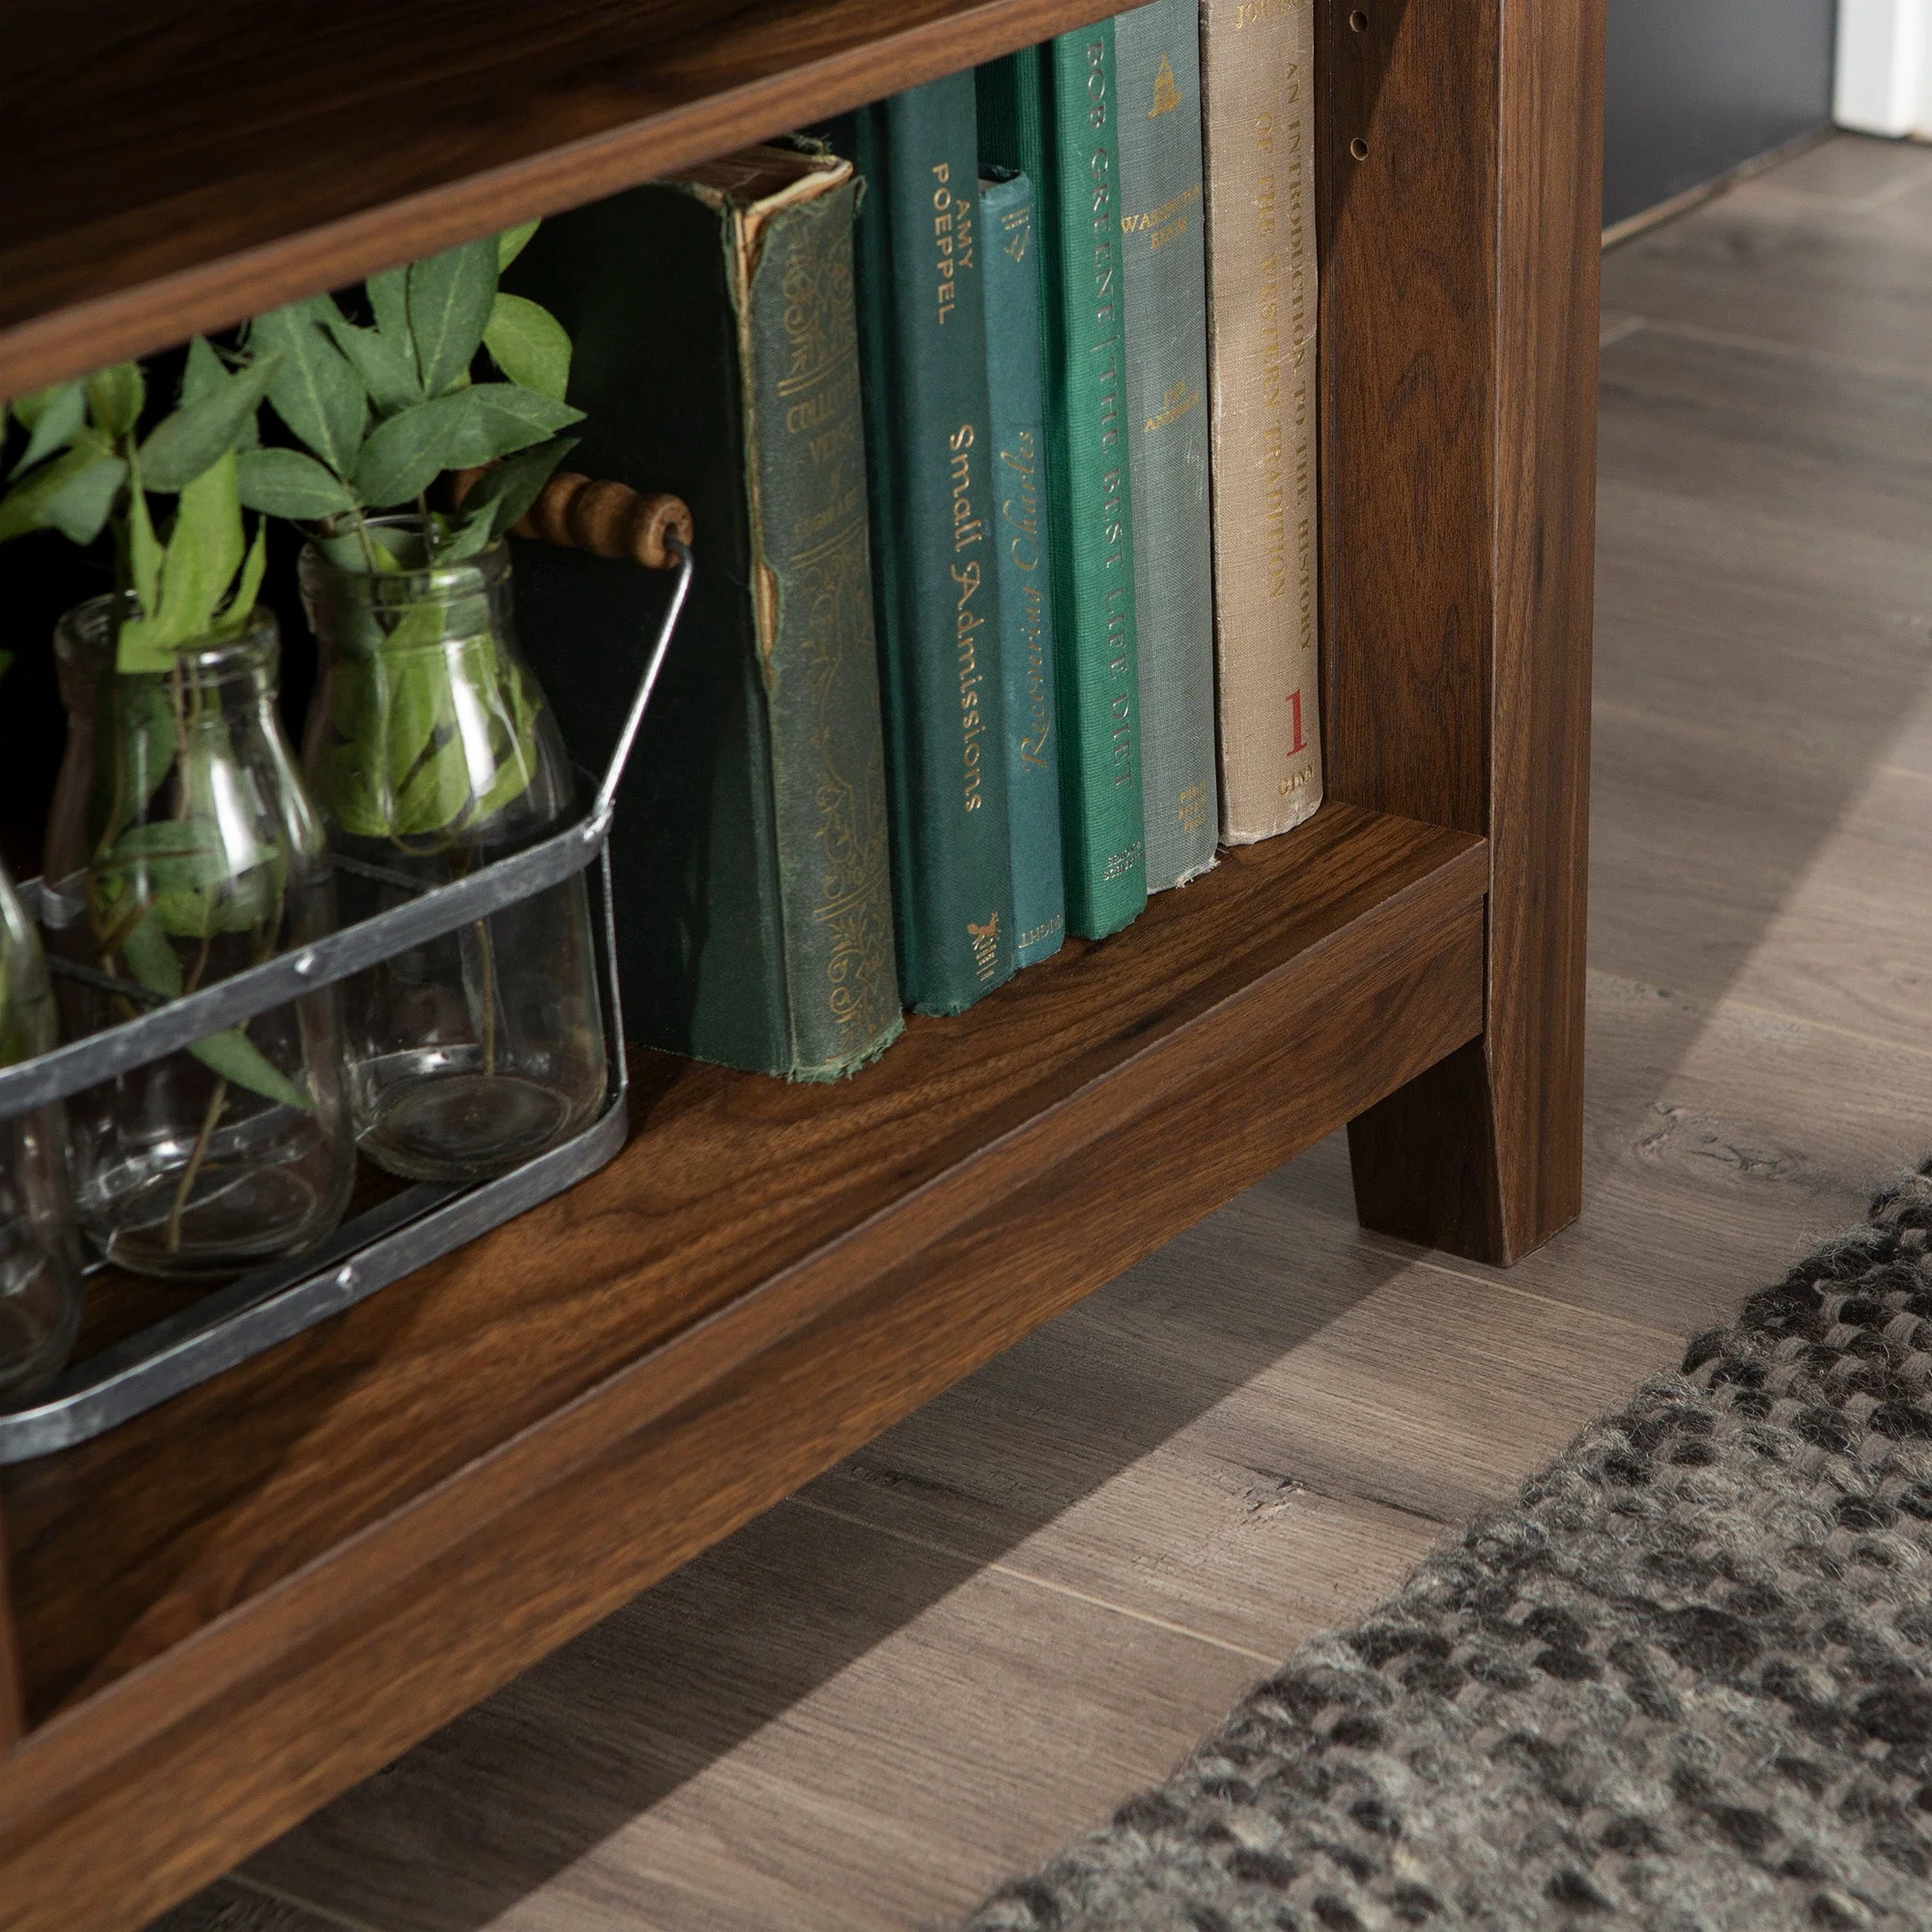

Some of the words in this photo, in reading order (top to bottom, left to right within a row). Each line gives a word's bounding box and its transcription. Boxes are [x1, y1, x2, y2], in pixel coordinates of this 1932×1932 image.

[1087, 37, 1106, 129] BOB
[932, 162, 955, 325] POEPPEL
[956, 199, 974, 269] AMY
[1092, 147, 1114, 329] GREENE
[1289, 118, 1306, 369] INTRODUCTION
[1260, 251, 1282, 409] WESTERN
[1098, 357, 1119, 454] THE
[1293, 377, 1307, 427] TO
[949, 424, 982, 553] Small
[1000, 431, 1040, 572] Charles
[1102, 468, 1124, 569] BEST
[1264, 410, 1286, 599] TRADITION
[1106, 585, 1128, 681] LIFE
[1297, 517, 1311, 650] HISTORY
[951, 560, 985, 812] Admissions
[1020, 585, 1053, 771] Recovering
[1112, 692, 1134, 789] DIET
[1285, 689, 1308, 758] 1
[1018, 915, 1063, 950] RIGHT
